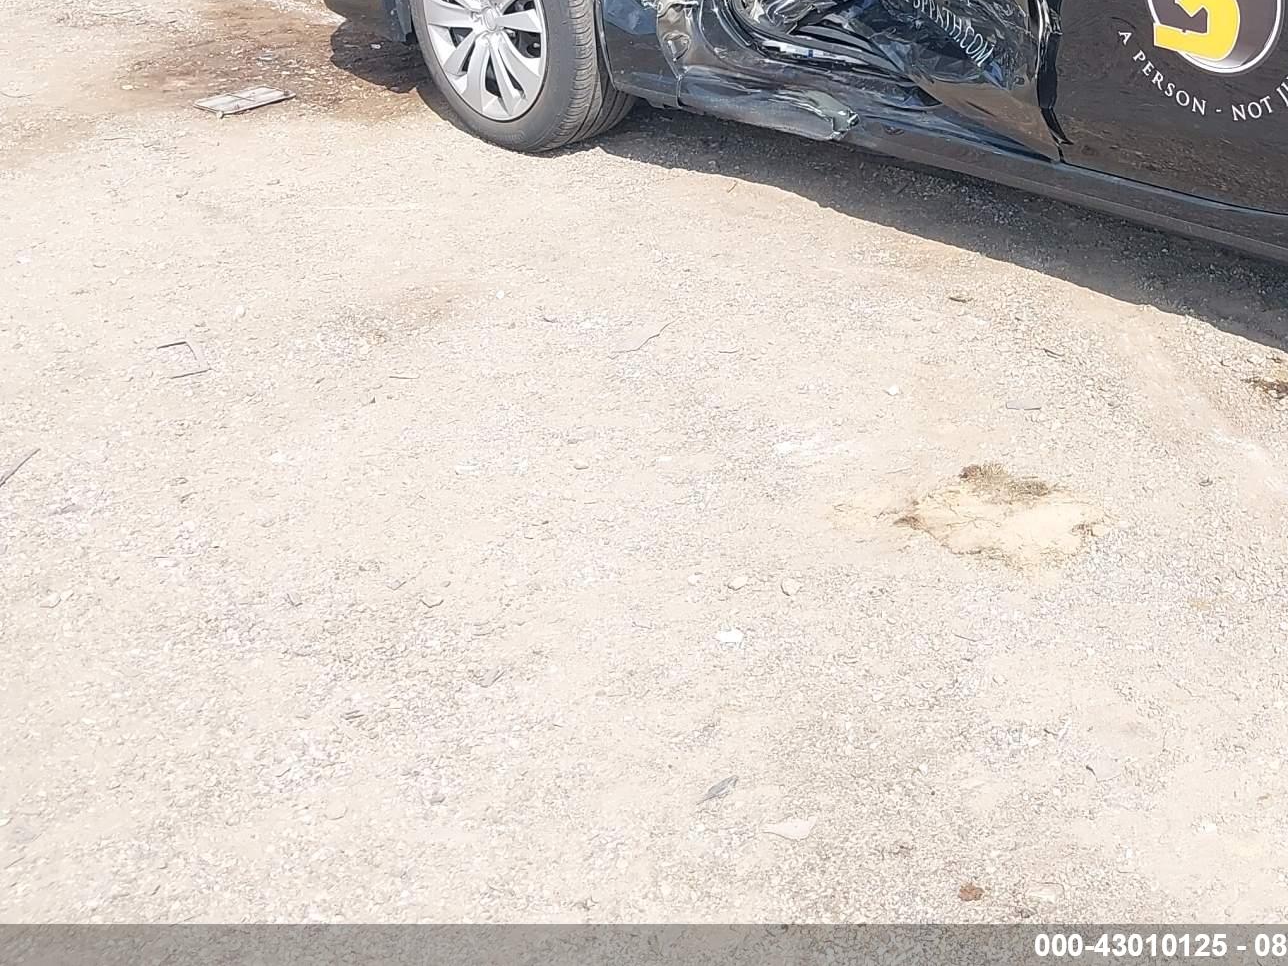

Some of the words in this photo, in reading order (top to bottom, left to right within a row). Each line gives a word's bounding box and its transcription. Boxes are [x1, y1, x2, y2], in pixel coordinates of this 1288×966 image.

[1117, 30, 1132, 45] A
[1132, 49, 1208, 116] PERSON
[1231, 94, 1275, 122] NOT
